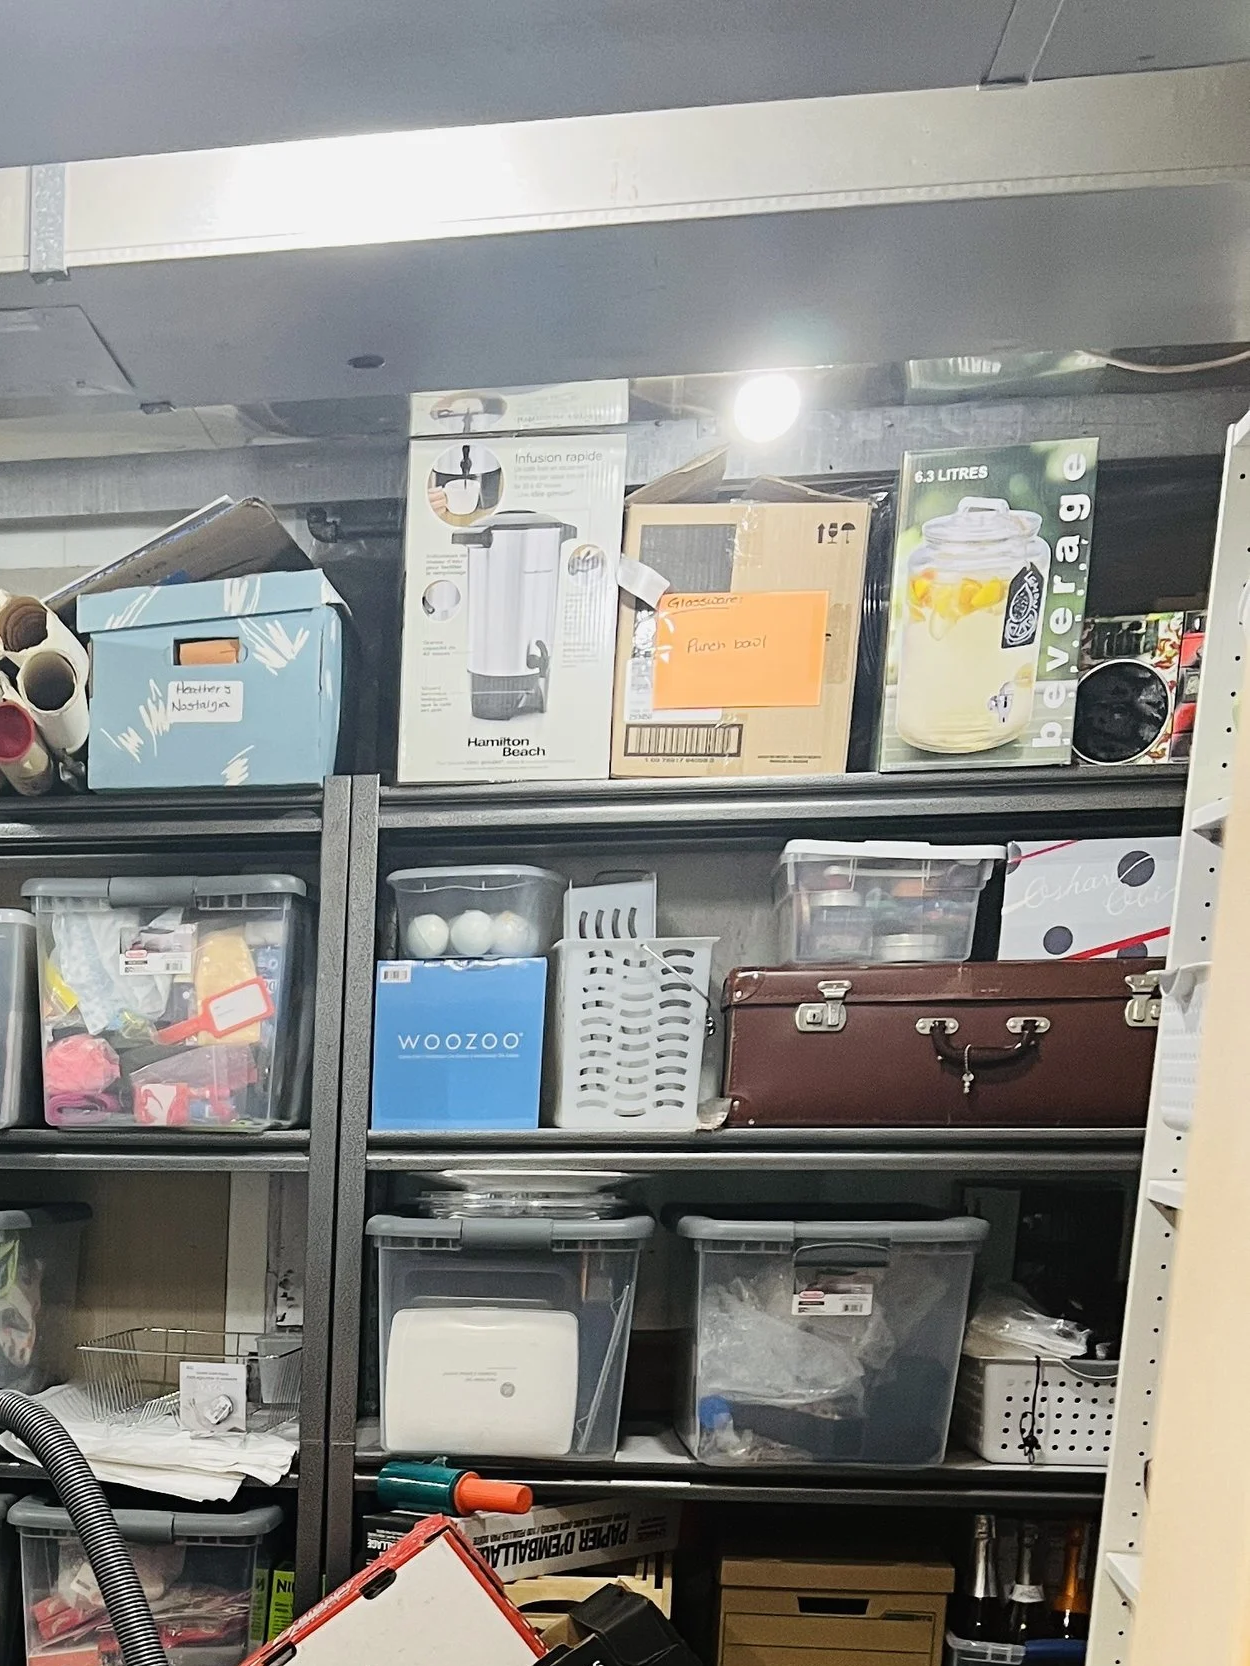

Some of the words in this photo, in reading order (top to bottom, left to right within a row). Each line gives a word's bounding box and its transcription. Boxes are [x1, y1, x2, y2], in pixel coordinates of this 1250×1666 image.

[515, 451, 562, 465] Infusion
[566, 451, 603, 464] rapide
[914, 470, 935, 484] 6.3
[938, 465, 989, 482] LITRES
[1032, 453, 1091, 748] beverage
[687, 637, 726, 653] Punch
[734, 635, 767, 649] bowl
[467, 737, 530, 748] Hamilton
[502, 747, 546, 757] Beach
[579, 1520, 629, 1552] PAPIER
